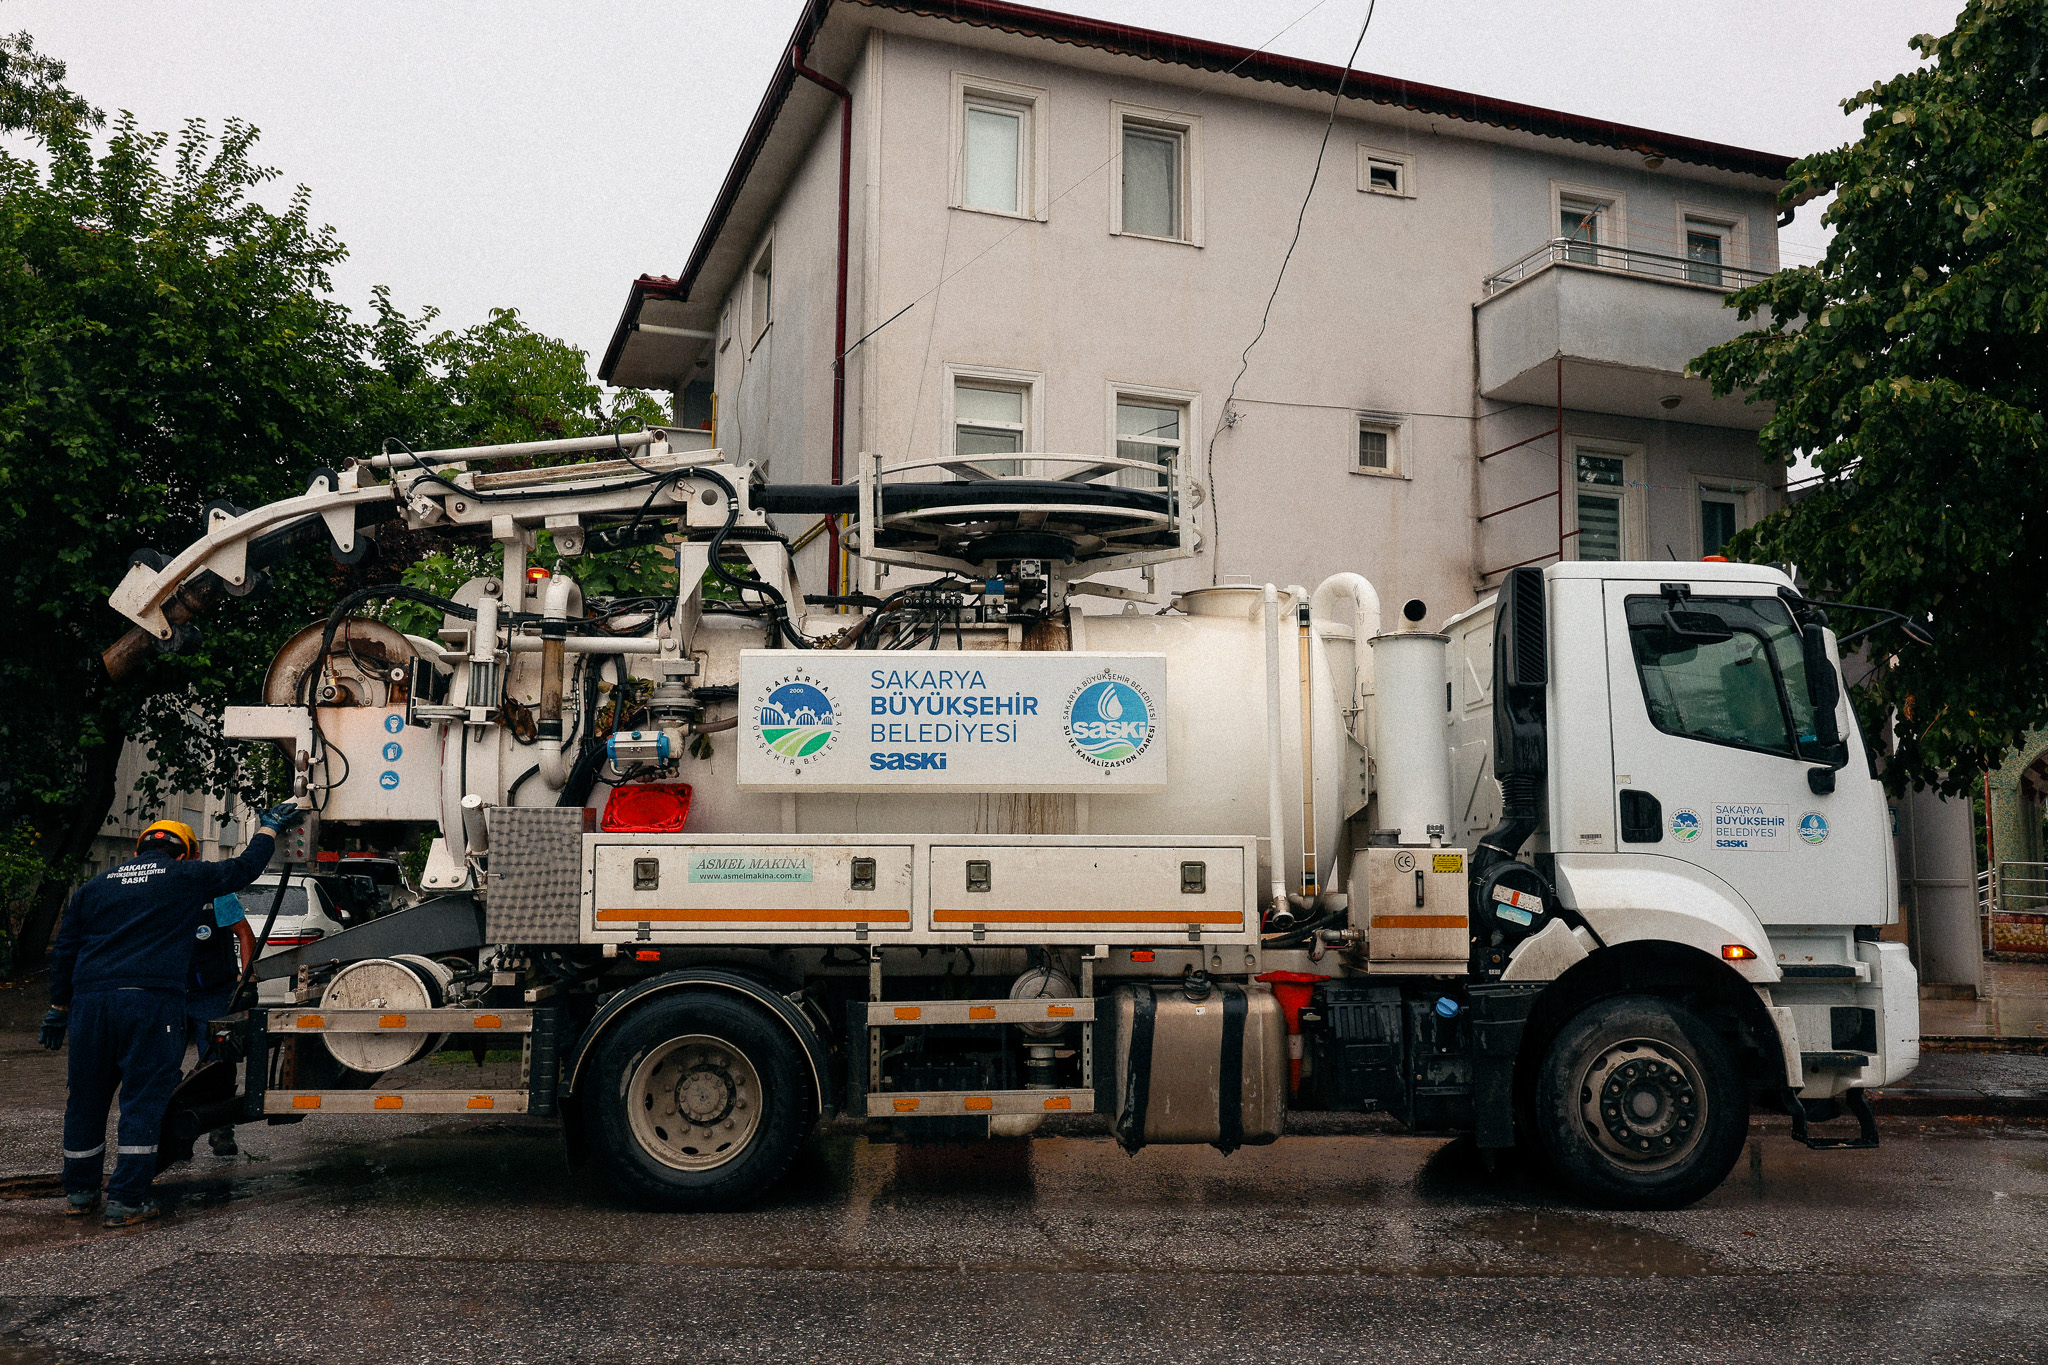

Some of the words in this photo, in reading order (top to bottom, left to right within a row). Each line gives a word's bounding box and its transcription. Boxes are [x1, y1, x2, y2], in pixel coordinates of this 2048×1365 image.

[766, 675, 829, 693] SAKARYA
[871, 670, 987, 689] SAKARYA
[1063, 686, 1082, 720] SAKARYA
[1082, 673, 1130, 688] BÜYÜKŞEHİR
[1131, 681, 1157, 720] BELEDİYESİ
[871, 691, 1038, 718] BÜYÜKŞEHİR
[871, 719, 1017, 742] BELEDİYESİ
[1063, 725, 1071, 736] SU
[1068, 738, 1077, 749] VE
[1076, 749, 1137, 768] KANALİZASYON
[1137, 725, 1156, 756] İDARESİ
[1716, 805, 1764, 814] SAKARYA
[1716, 815, 1785, 826] BÜYÜKŞEHİR
[1716, 827, 1777, 837] BELEDİYESİ
[118, 863, 157, 872] SAKARYA
[696, 858, 746, 869] ASMEL
[700, 872, 802, 880] www.asmelmakina.com.tr
